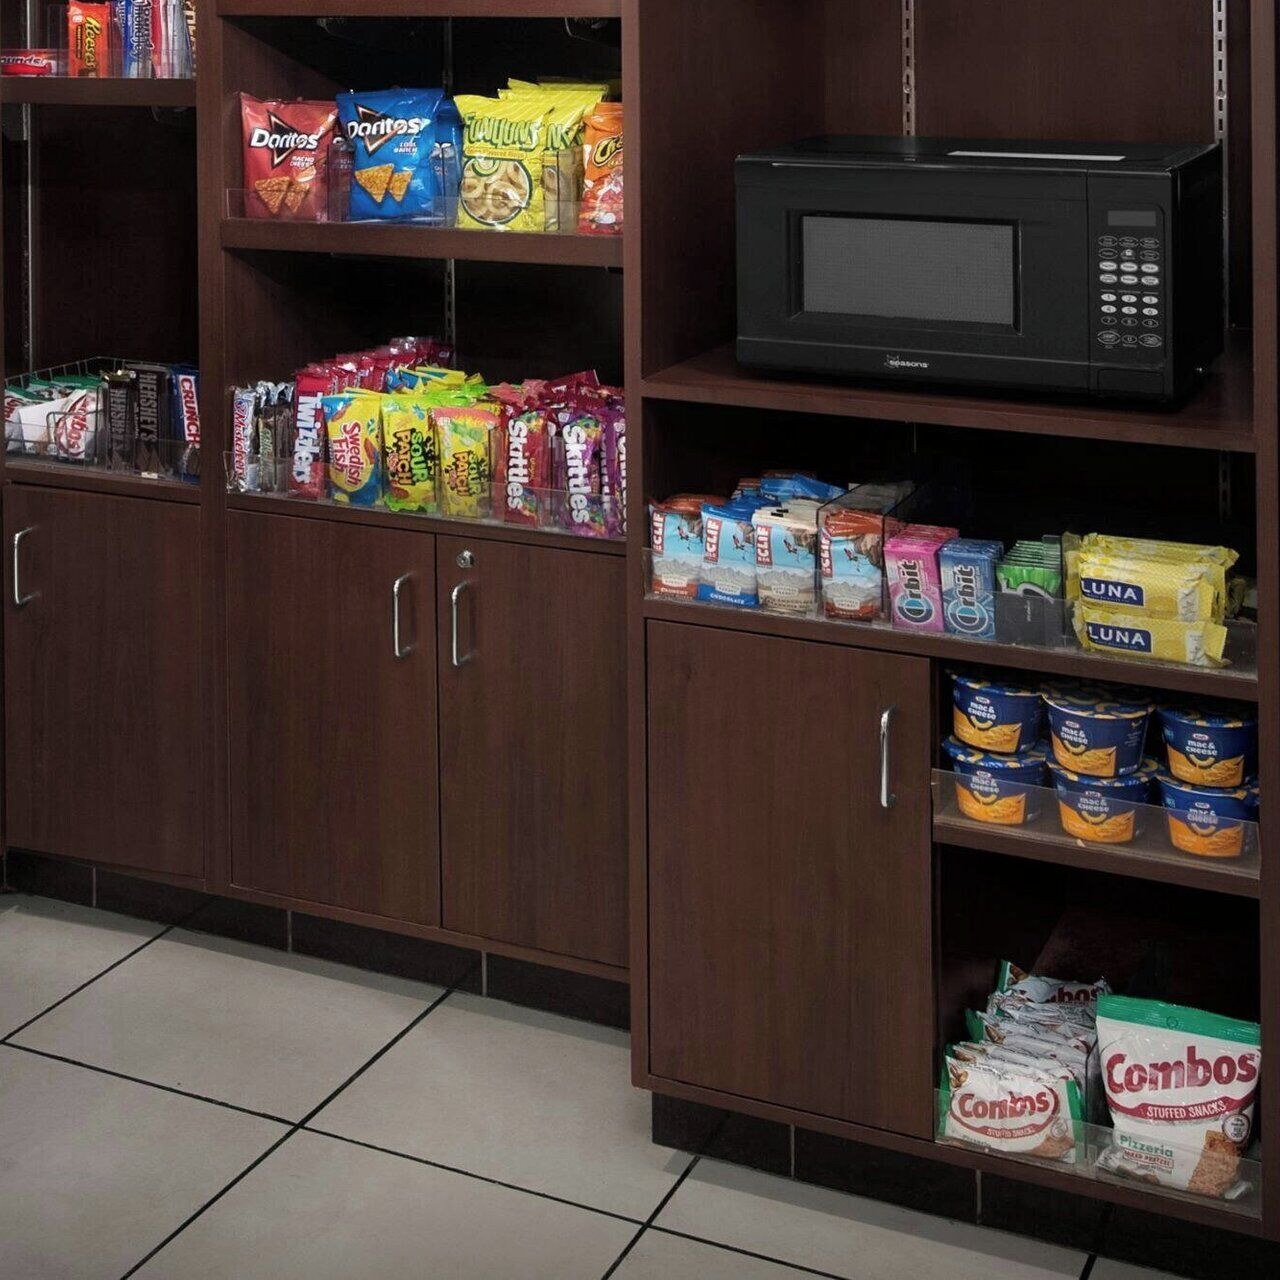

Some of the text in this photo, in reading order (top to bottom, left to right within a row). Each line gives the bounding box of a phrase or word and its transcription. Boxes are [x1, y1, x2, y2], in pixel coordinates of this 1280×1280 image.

[250, 128, 319, 150] Doritos
[348, 118, 420, 139] Doritos
[180, 377, 200, 445] CRUNCH
[332, 438, 349, 473] Fish
[344, 422, 364, 486] Swedish
[395, 428, 414, 486] PATCH
[410, 431, 428, 485] SOUR
[455, 452, 470, 496] PATCH
[506, 419, 525, 510] Skittles
[563, 424, 590, 524] Skittles
[1081, 582, 1138, 600] LUNA
[1088, 625, 1146, 646] LUNA
[1106, 1046, 1257, 1094] Combos
[1146, 1100, 1226, 1119] STUFFED SNACKS
[1120, 1135, 1173, 1157] Pizzeria
